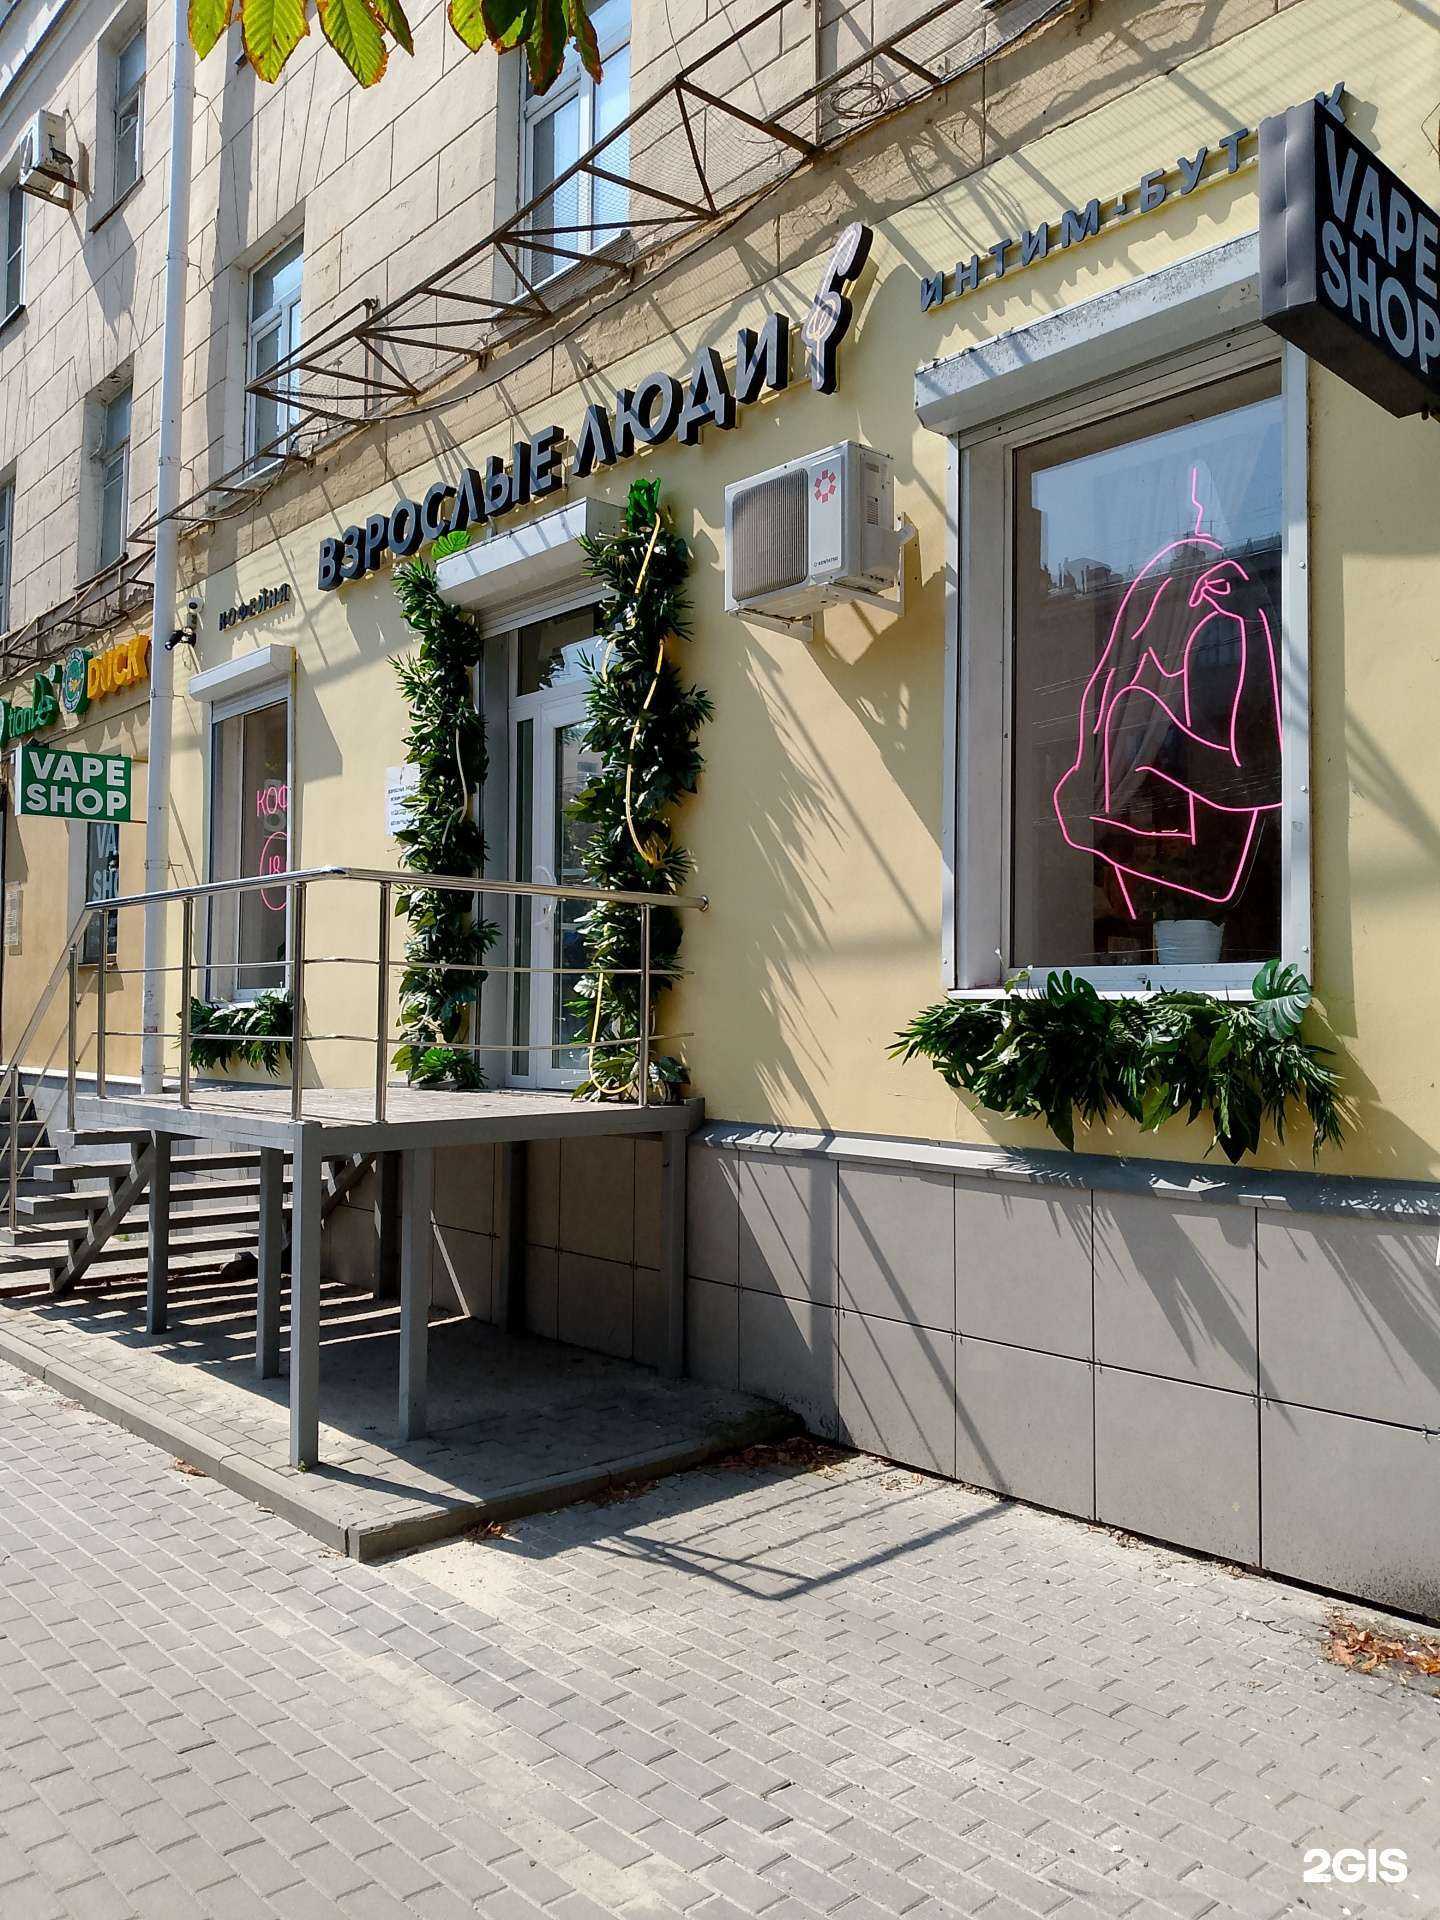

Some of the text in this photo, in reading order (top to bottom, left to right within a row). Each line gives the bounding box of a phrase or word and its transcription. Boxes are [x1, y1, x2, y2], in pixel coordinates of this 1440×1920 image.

[920, 81, 1346, 312] ИНТИМ-БУТК
[1325, 124, 1439, 300] VAPE
[1322, 220, 1440, 374] SHOP
[318, 312, 789, 592] ВЗРОСЛЫЕ ЛЮДИ
[87, 635, 150, 699] DUCK
[26, 784, 127, 816] SHOP
[29, 752, 125, 786] VAPE
